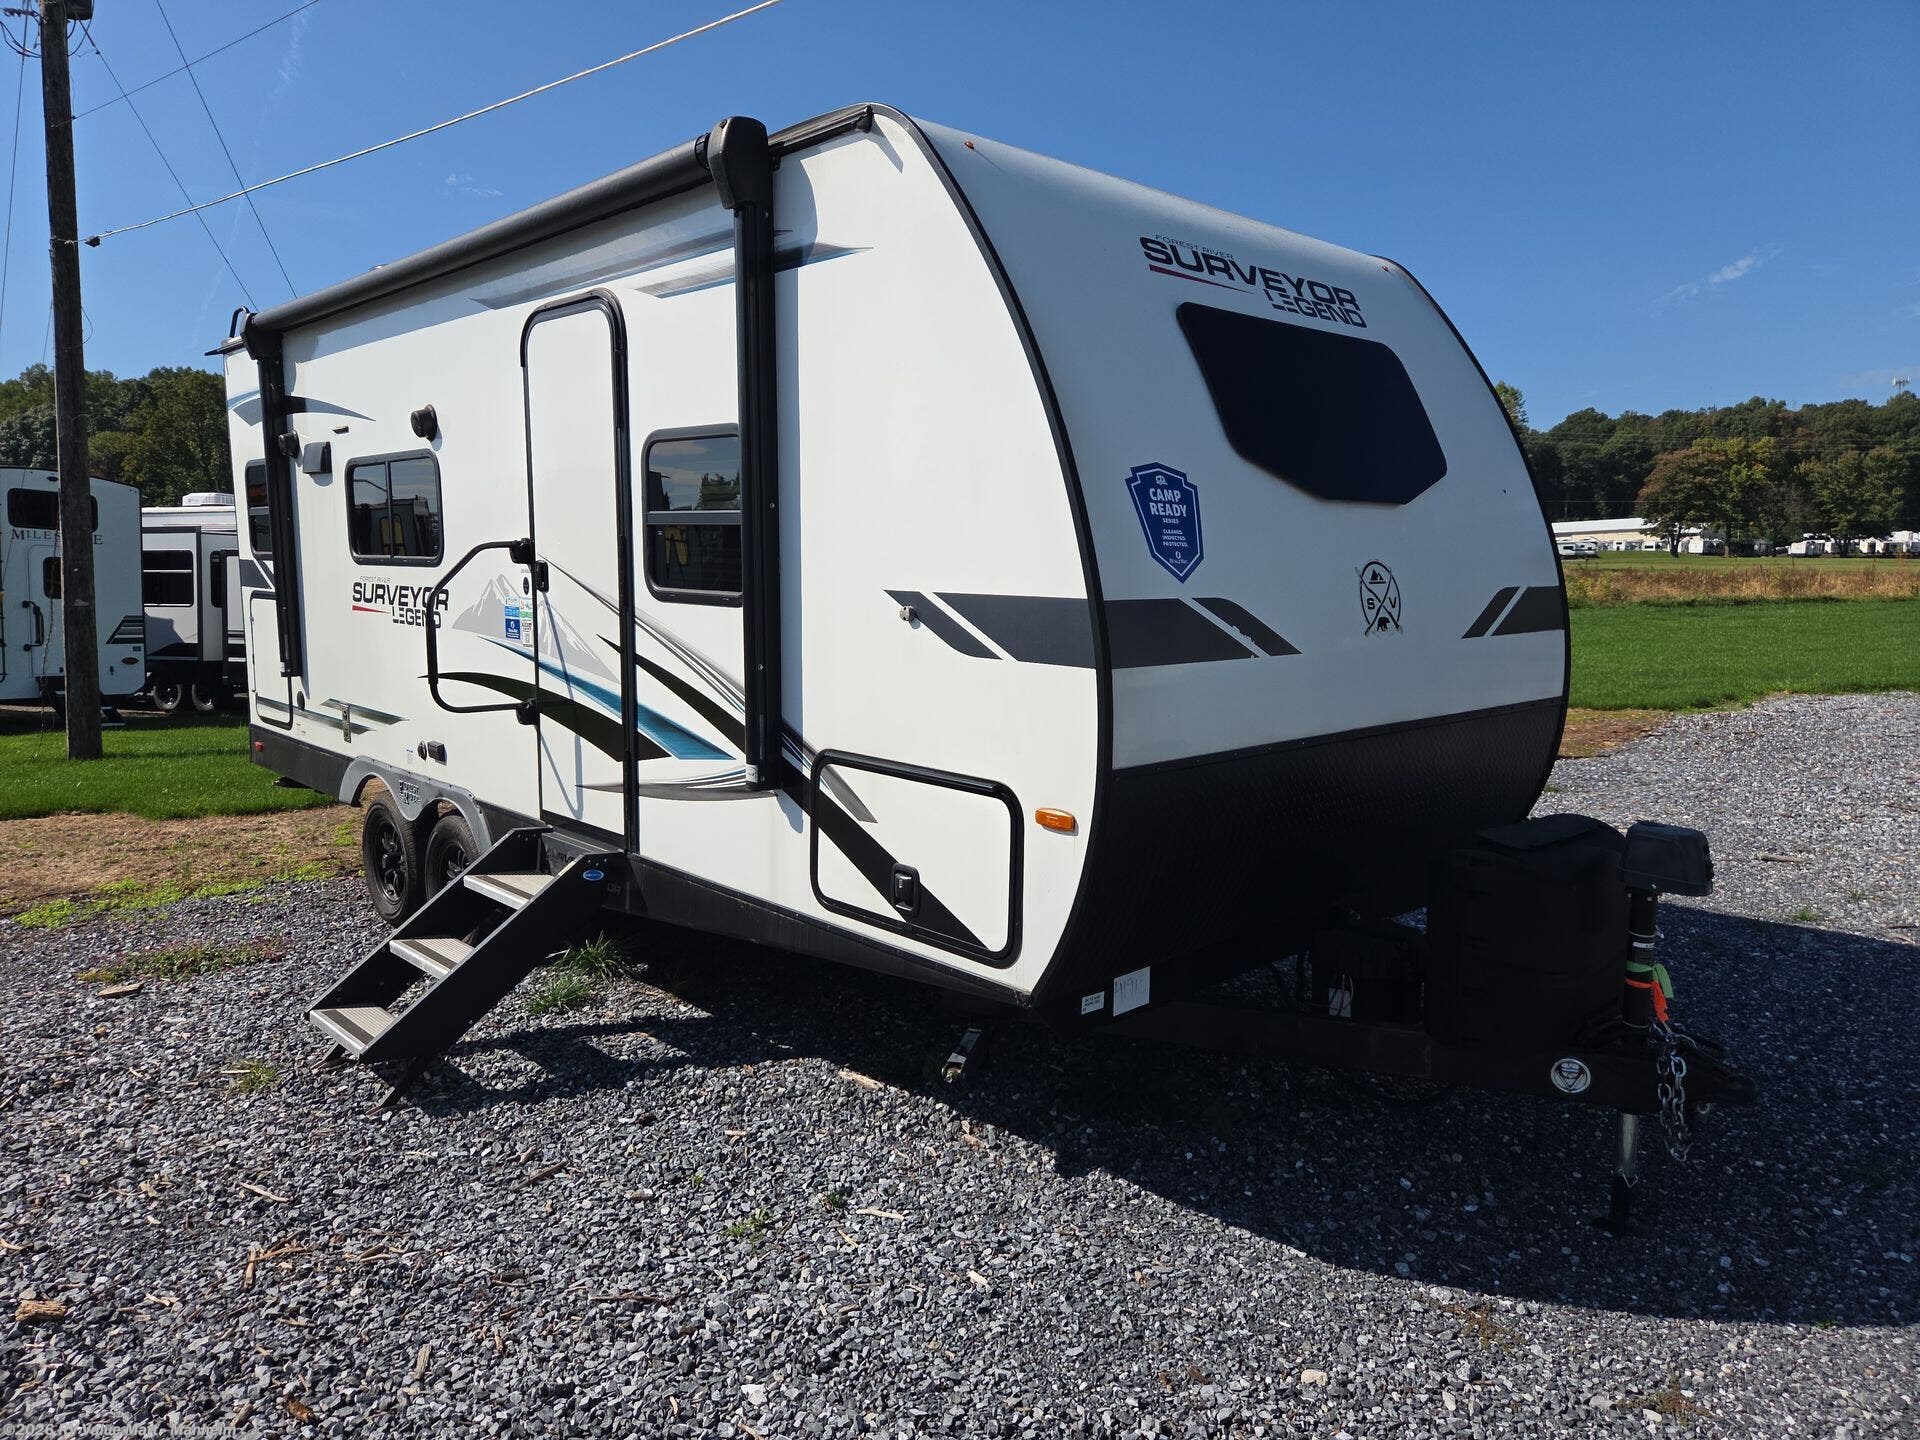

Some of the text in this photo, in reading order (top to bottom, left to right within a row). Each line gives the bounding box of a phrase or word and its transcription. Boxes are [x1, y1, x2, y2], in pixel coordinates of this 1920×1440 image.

[1155, 234, 1235, 260] FOREST RIVER
[1139, 236, 1361, 311] SURVEYOR
[1263, 288, 1368, 329] LEGEND
[1149, 488, 1181, 502] CAMP
[1149, 502, 1187, 517] READY
[11, 528, 104, 545] MILESE
